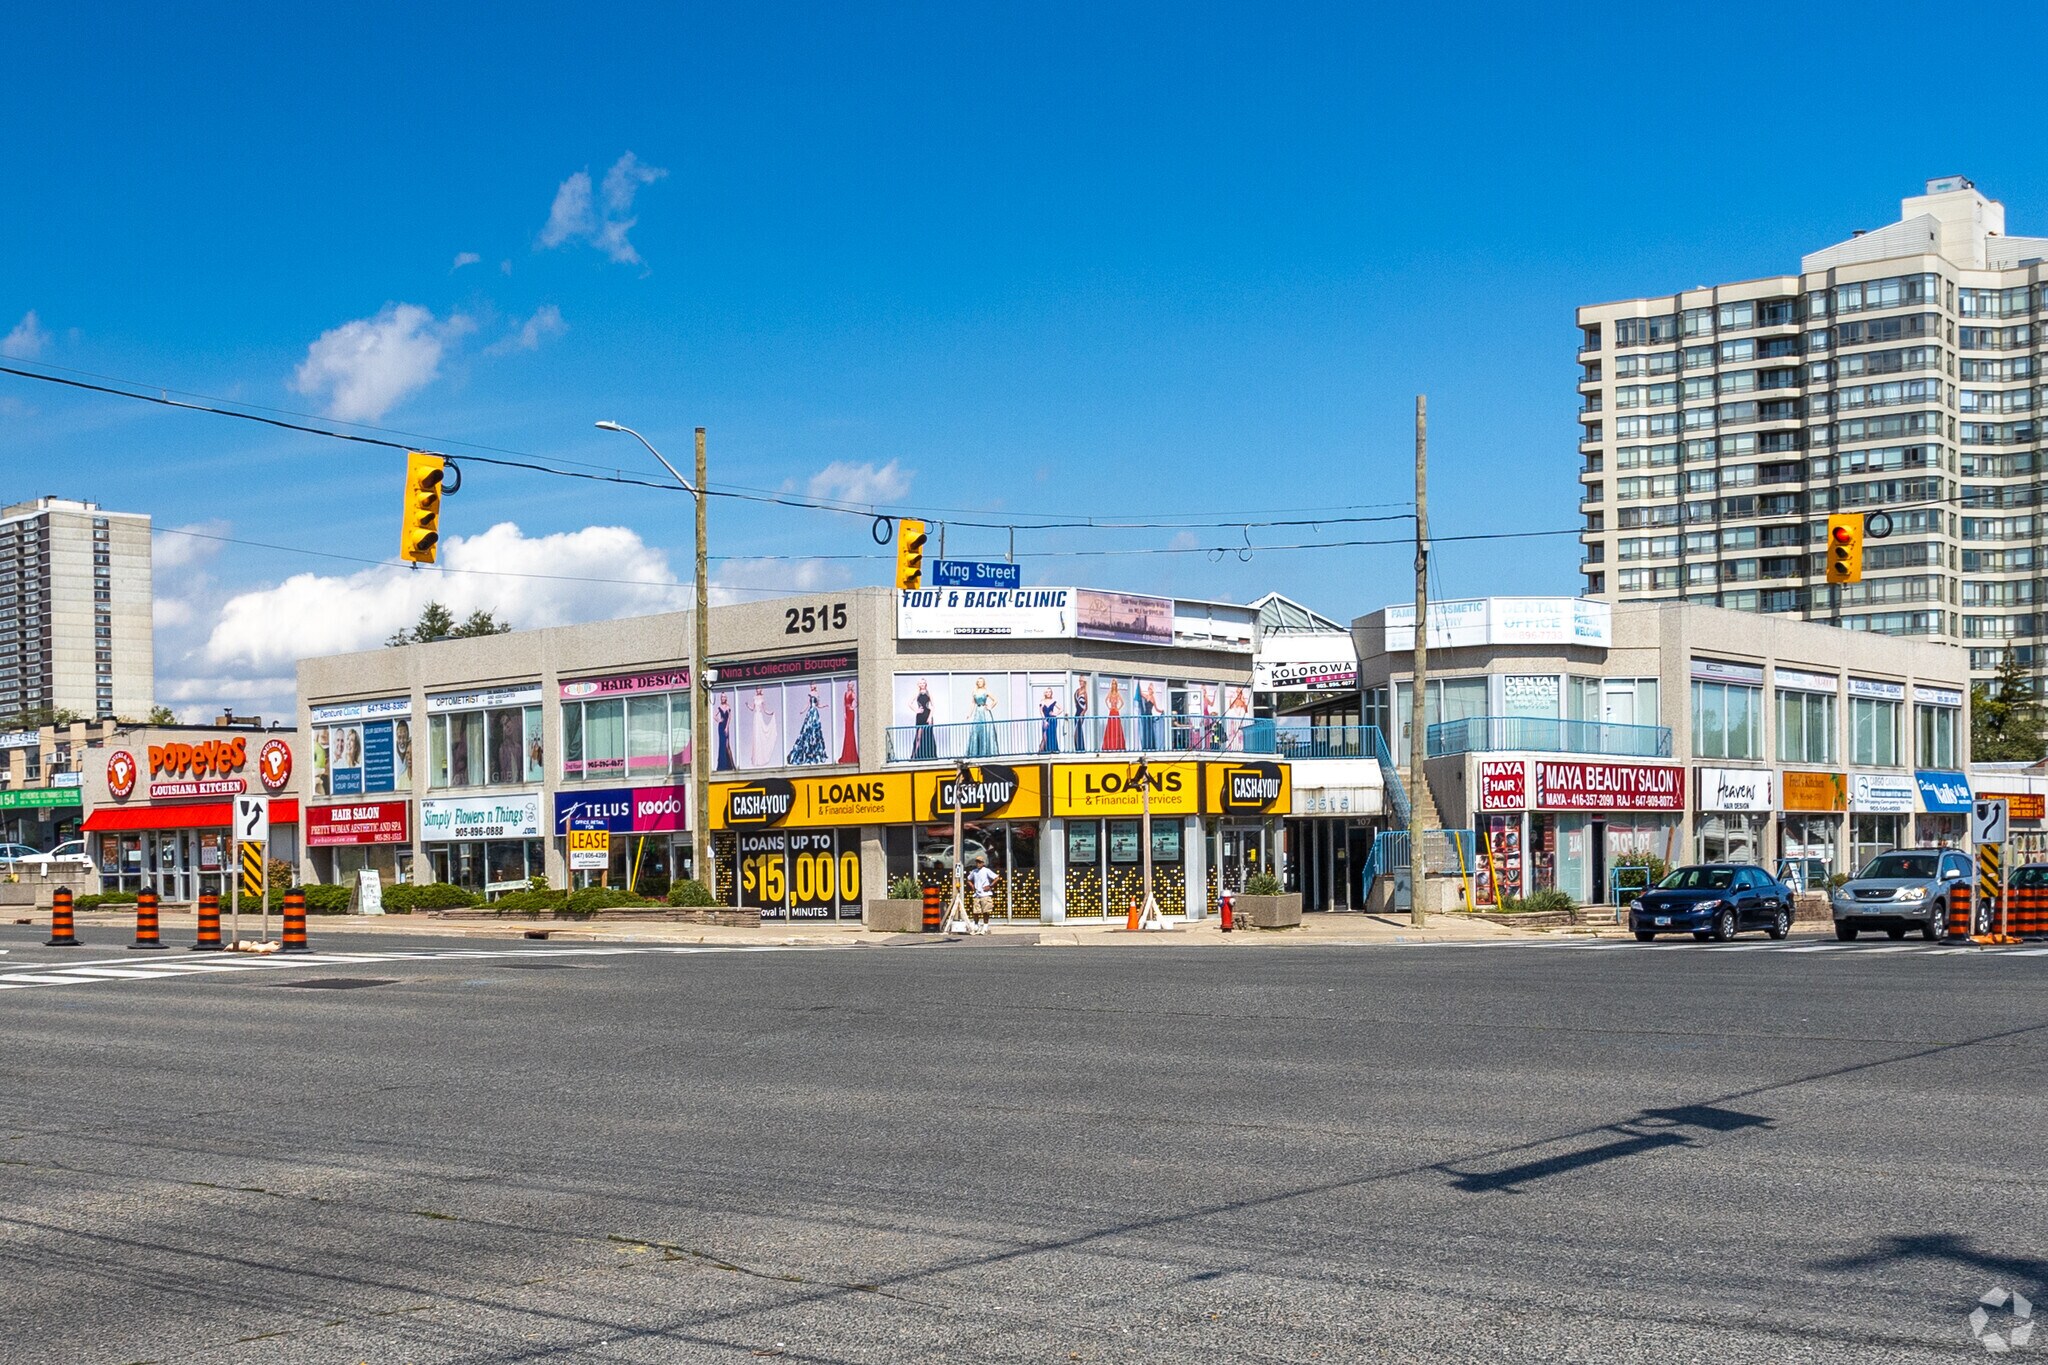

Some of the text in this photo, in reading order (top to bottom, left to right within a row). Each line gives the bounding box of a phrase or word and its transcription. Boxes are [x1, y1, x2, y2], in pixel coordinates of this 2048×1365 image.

[939, 562, 1016, 580] King Street
[902, 590, 1067, 608] FOOT & BACK CLINIC
[1436, 603, 1483, 616] COSMETIC
[1502, 602, 1562, 613] DENTAL
[785, 603, 847, 634] 2515
[1504, 616, 1560, 628] OFFICE
[721, 657, 848, 679] Ninas Collection Boutique
[1271, 662, 1352, 679] KOLOROWA
[600, 679, 633, 692] HAIR
[637, 672, 688, 688] DESIGN
[1310, 674, 1355, 682] DESIGN
[1505, 676, 1559, 686] DENTAL
[1505, 685, 1559, 695] OFFICE
[436, 694, 479, 706] OPTOMETRIST
[1483, 763, 1524, 776] MAYA
[1490, 780, 1516, 791] HAIR
[1546, 765, 1674, 793] MAYA BEAUTY SALON
[152, 781, 241, 796] LOUISIANA KITCHEN
[818, 782, 885, 804] LOANS
[1234, 777, 1279, 799] CASH4YOU
[1717, 769, 1756, 807] Heavens
[1932, 782, 1958, 805] Nails
[733, 794, 787, 816] CASH4YOU
[1085, 794, 1182, 805] & Financial ervices
[1306, 795, 1349, 811] 2515
[1485, 794, 1524, 808] SALON
[1546, 794, 1568, 806] MAYA
[1617, 795, 1631, 806] RAJ
[331, 806, 380, 821] HAIR SALON
[585, 802, 629, 817] TELUS
[818, 803, 885, 815] & Financial Services
[424, 806, 524, 830] Simply Flowers n Things
[1356, 817, 1372, 826] 107
[310, 824, 330, 835] PRETTY
[351, 822, 379, 833] AESTHETIC
[379, 822, 391, 832] AND
[391, 821, 402, 831] SPA
[522, 827, 537, 835] .com
[572, 832, 607, 849] LEASE
[742, 835, 831, 851] LOANS UP TO
[742, 850, 860, 907] $15,000
[760, 907, 828, 917] oval in MINUTES
